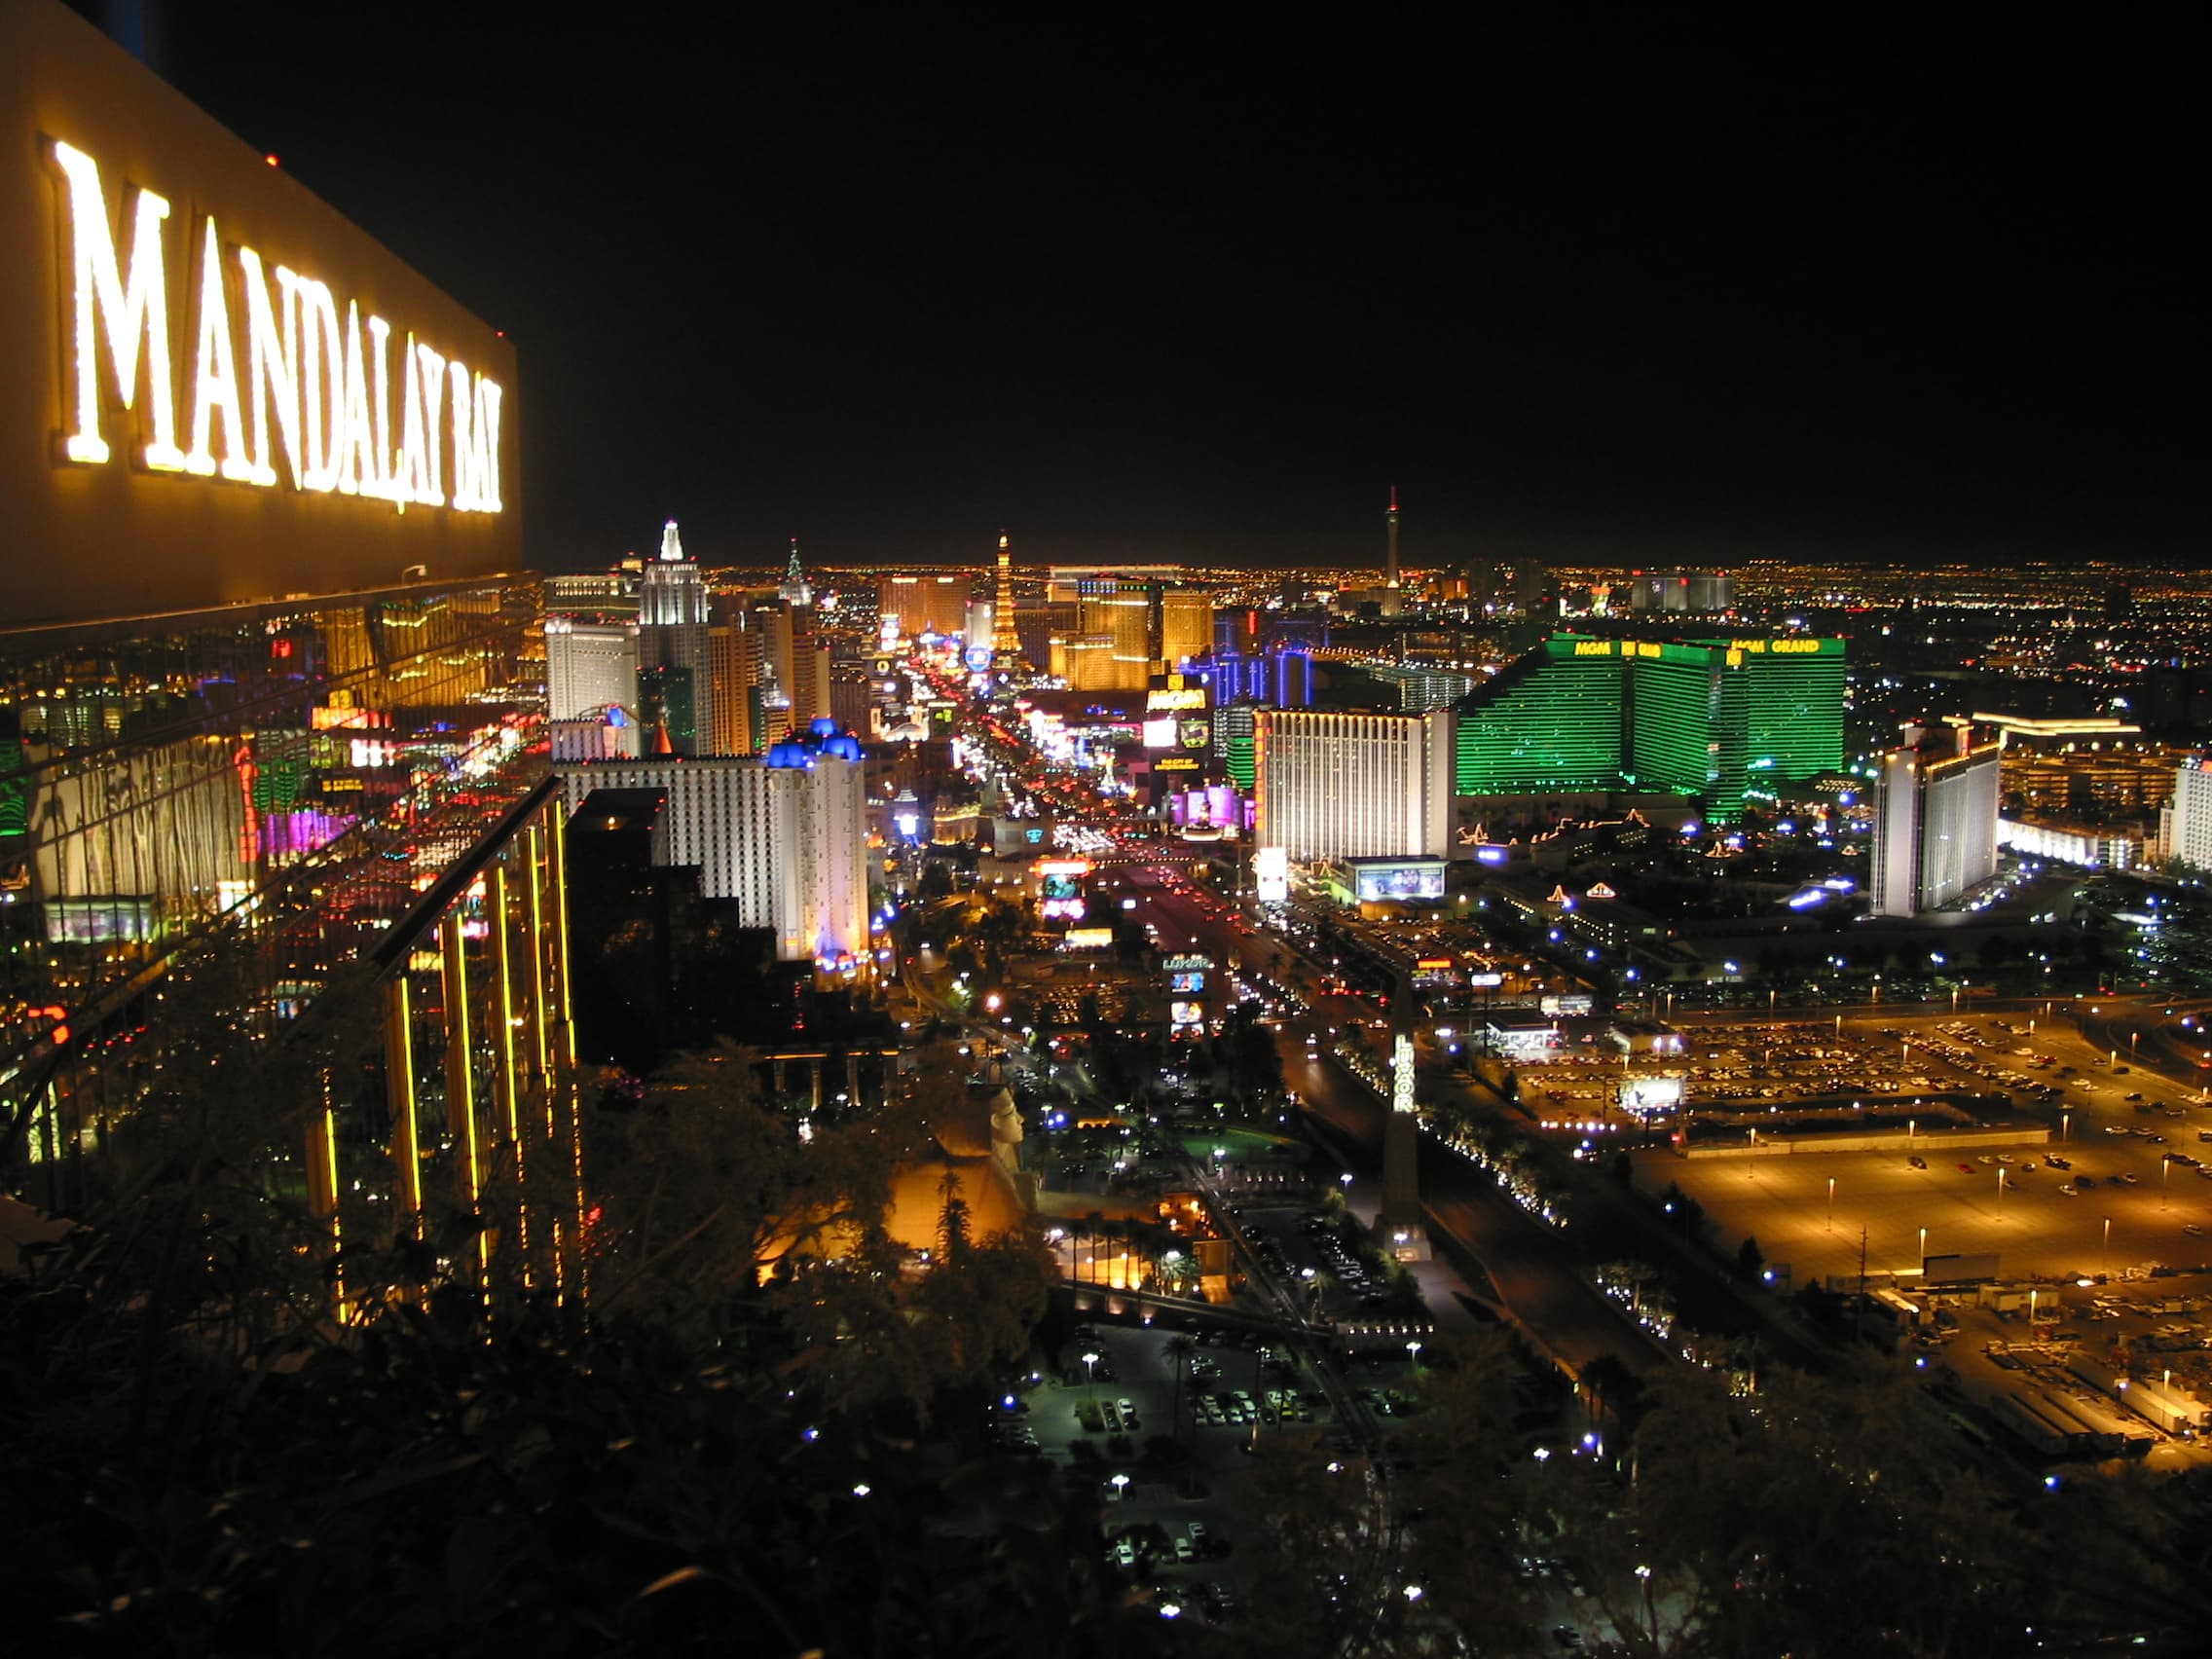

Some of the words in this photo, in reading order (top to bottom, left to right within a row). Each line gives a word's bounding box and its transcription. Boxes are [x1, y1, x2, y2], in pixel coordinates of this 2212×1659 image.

[55, 140, 446, 507] MANDALAY
[451, 360, 503, 513] BAY
[1574, 641, 1612, 656] MGM
[1771, 639, 1821, 653] GRAND
[1147, 689, 1206, 710] MGM
[1162, 959, 1209, 970] LUXOR
[1394, 1034, 1416, 1113] LUXOR
